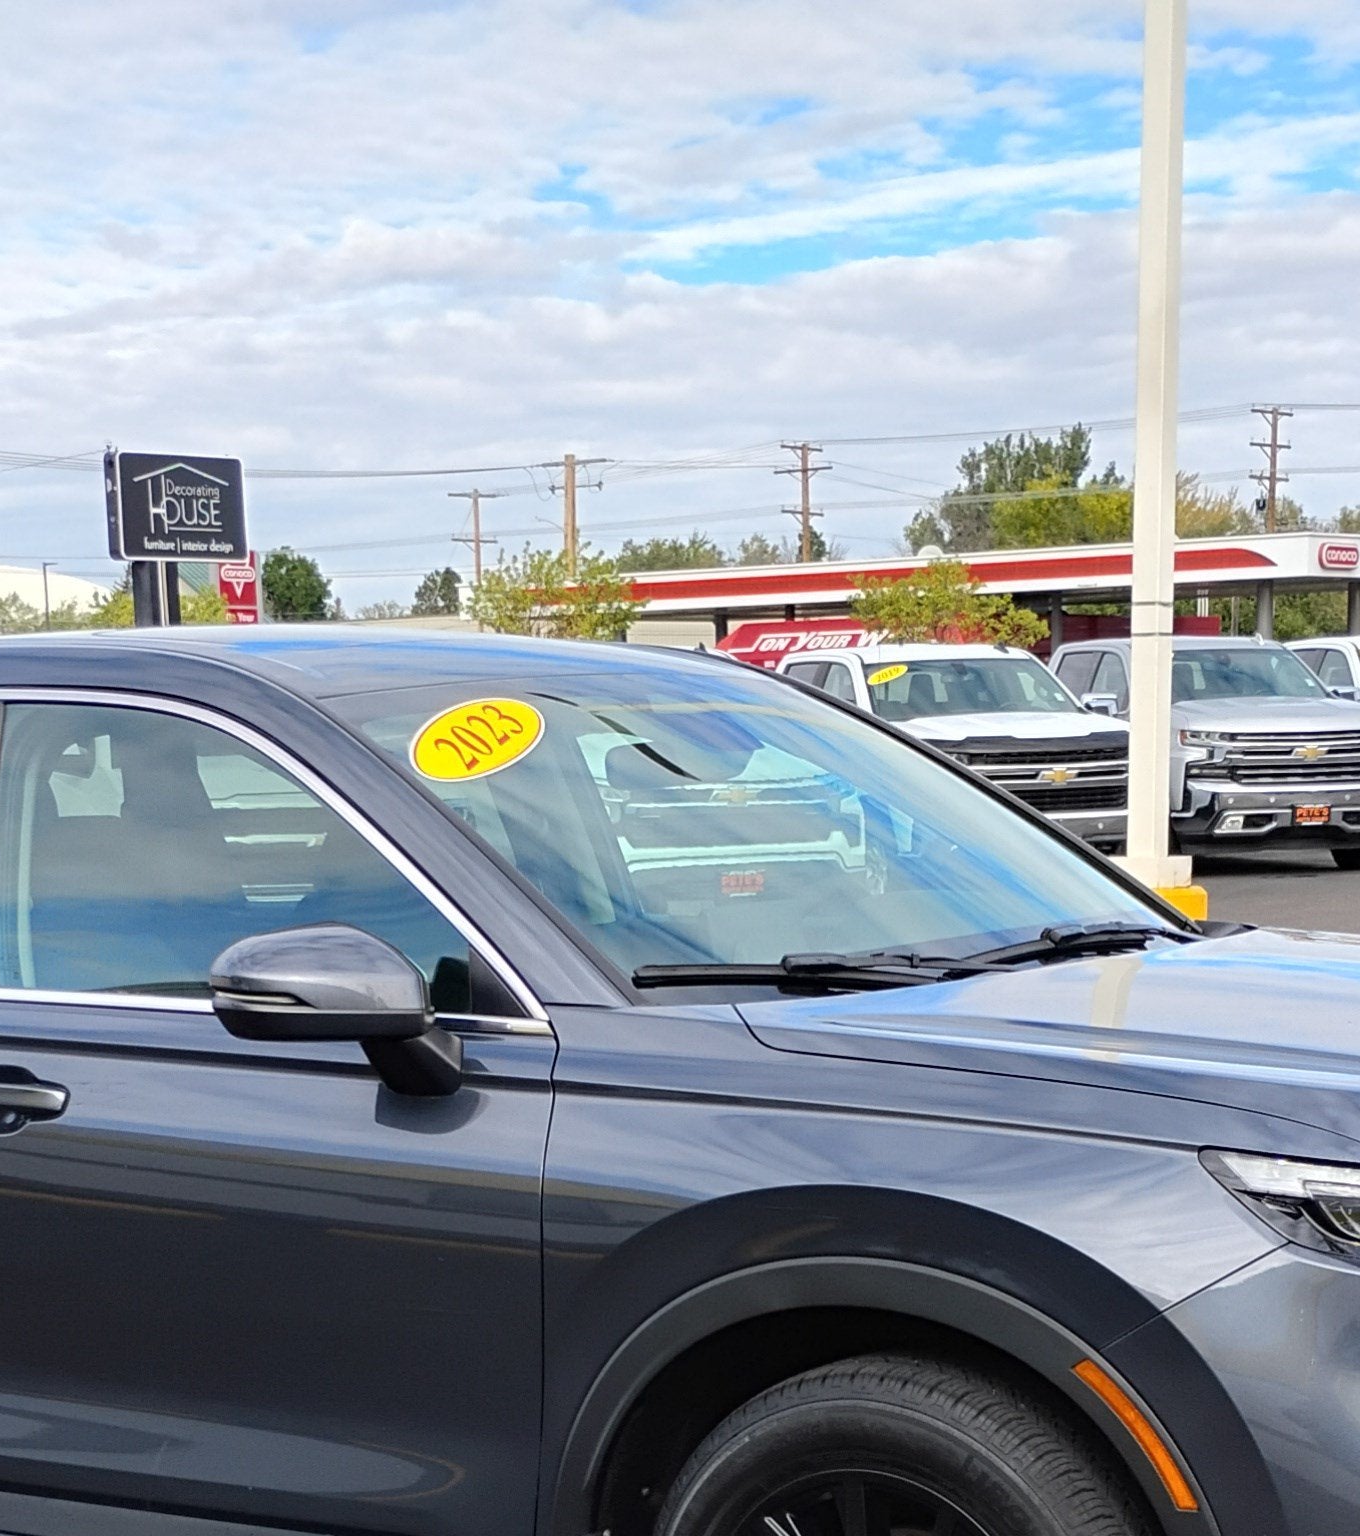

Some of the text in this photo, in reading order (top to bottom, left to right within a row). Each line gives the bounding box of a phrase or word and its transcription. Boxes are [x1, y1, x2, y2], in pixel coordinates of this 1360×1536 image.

[166, 478, 220, 500] Decorating
[144, 536, 234, 554] furniture interior design
[758, 637, 792, 652] ON
[434, 705, 524, 772] 2023
[1296, 807, 1329, 817] PETE'S
